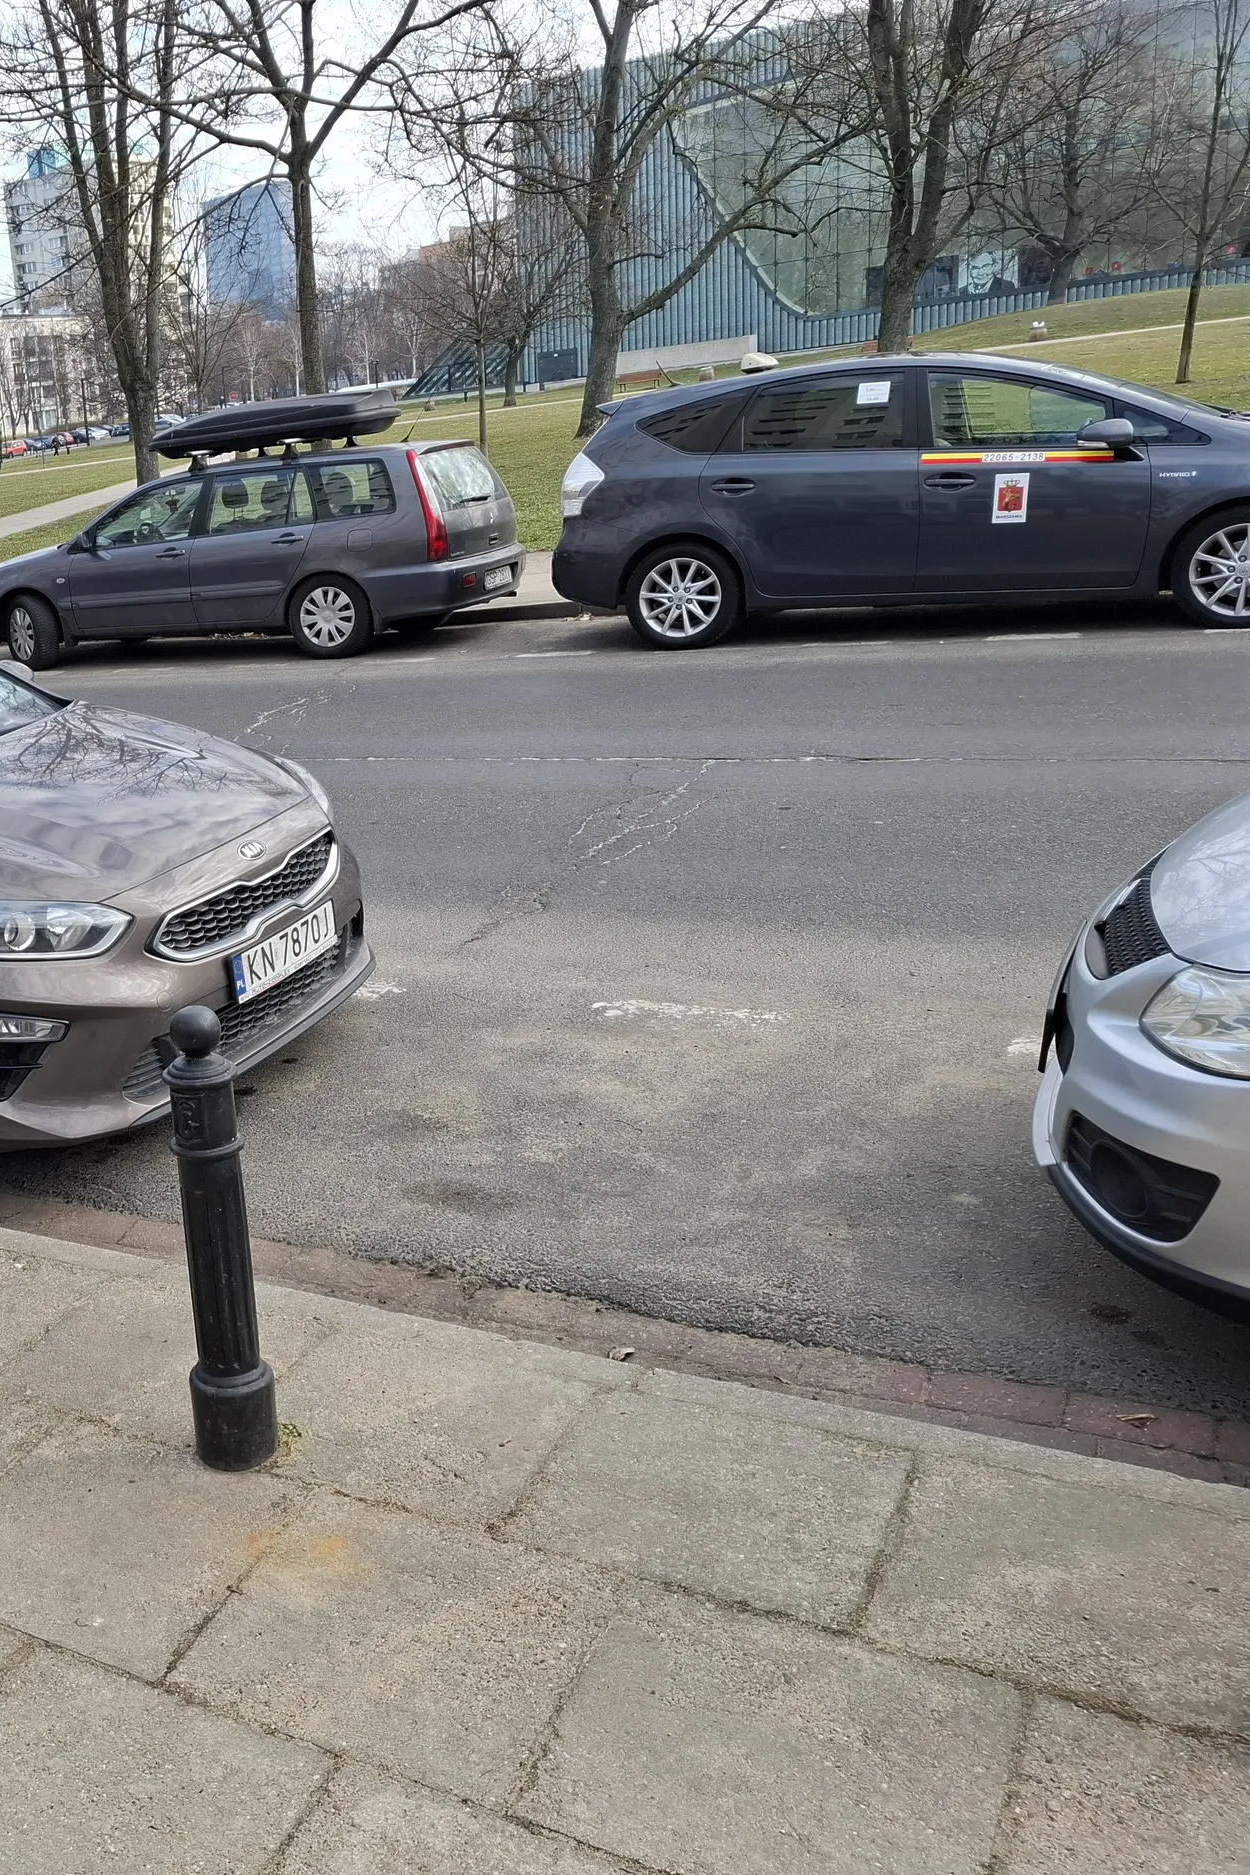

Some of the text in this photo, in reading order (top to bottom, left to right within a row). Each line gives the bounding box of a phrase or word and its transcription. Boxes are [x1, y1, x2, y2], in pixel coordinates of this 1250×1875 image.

[983, 452, 1044, 461] 22065-2138
[240, 841, 264, 858] KIA
[247, 907, 329, 985] KN 7870J
[236, 980, 245, 990] PL
